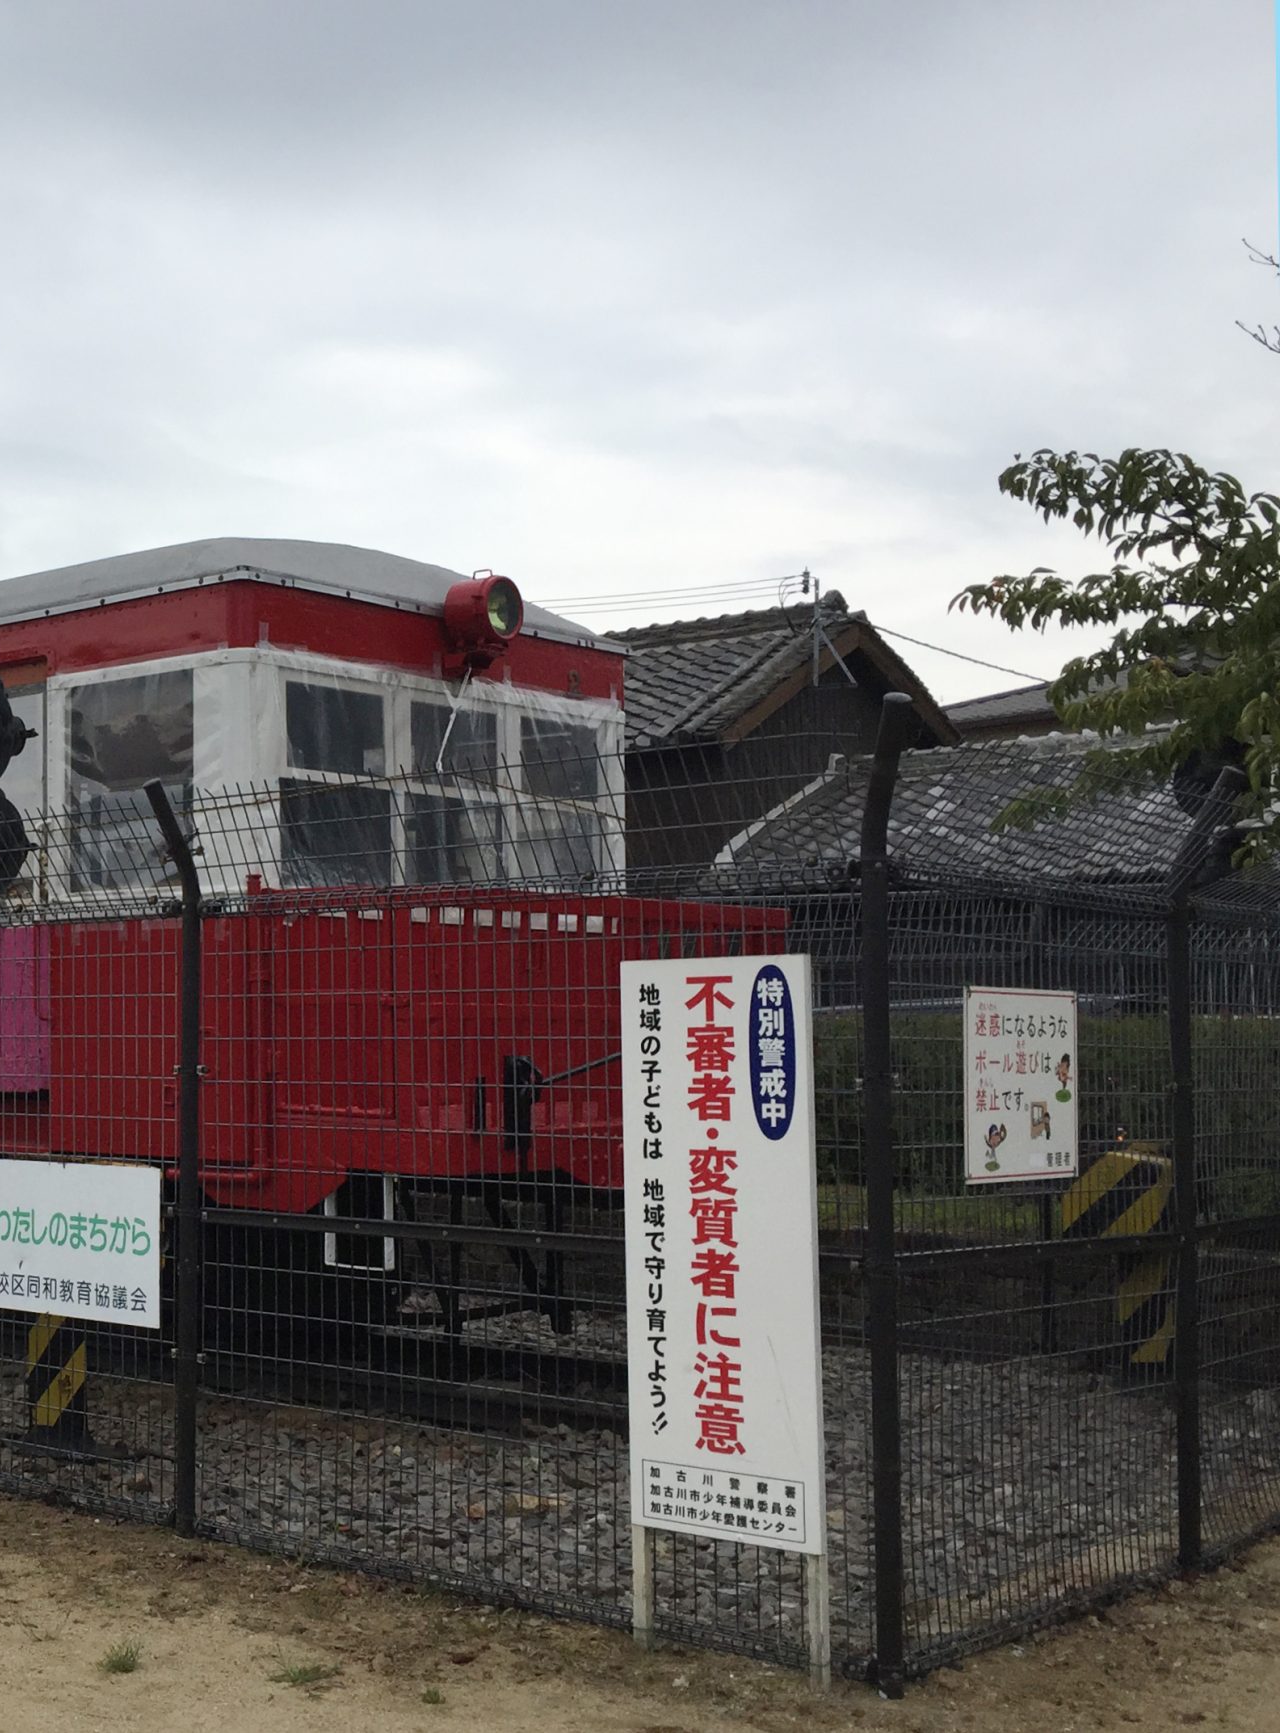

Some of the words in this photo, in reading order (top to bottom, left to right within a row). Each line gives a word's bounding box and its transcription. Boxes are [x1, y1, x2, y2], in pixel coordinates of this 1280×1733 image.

[975, 1013, 1068, 1039] 迷惑になるような
[757, 978, 787, 1127] 特別警戒中
[975, 1050, 1052, 1075] ボール遊びは
[639, 983, 663, 1160] 地域の子どもは
[976, 1087, 1029, 1112] 禁止です。
[685, 975, 746, 1455] 不審者・変質者に注意
[650, 1484, 797, 1518] 加古川市少年補導委員会
[650, 1501, 798, 1533] 加古川市少年愛護センター
